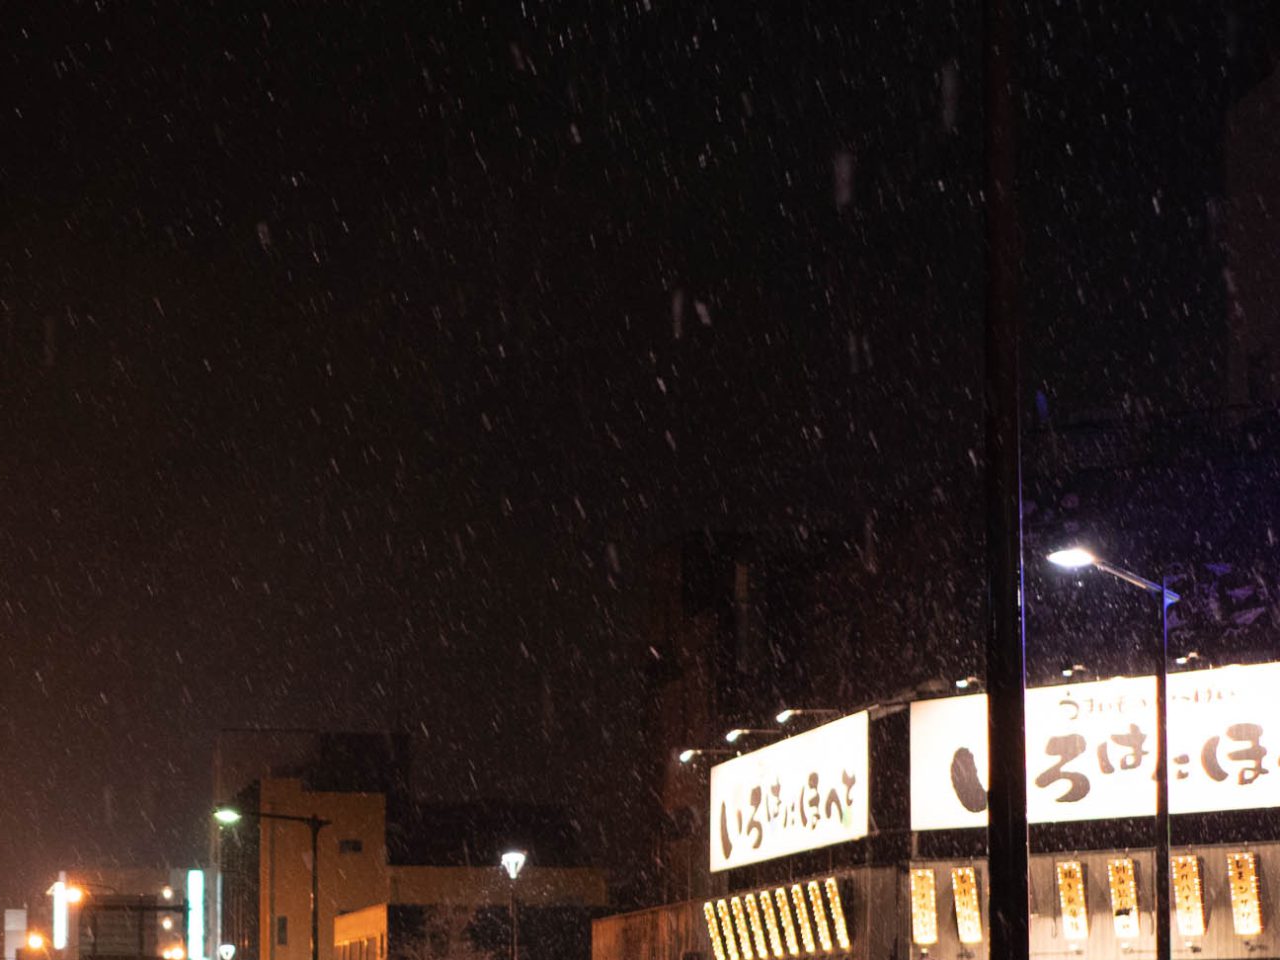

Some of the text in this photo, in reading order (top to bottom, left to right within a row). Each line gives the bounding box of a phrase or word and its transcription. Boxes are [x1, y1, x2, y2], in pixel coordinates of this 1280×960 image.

[720, 768, 856, 860] いろはにほへと
